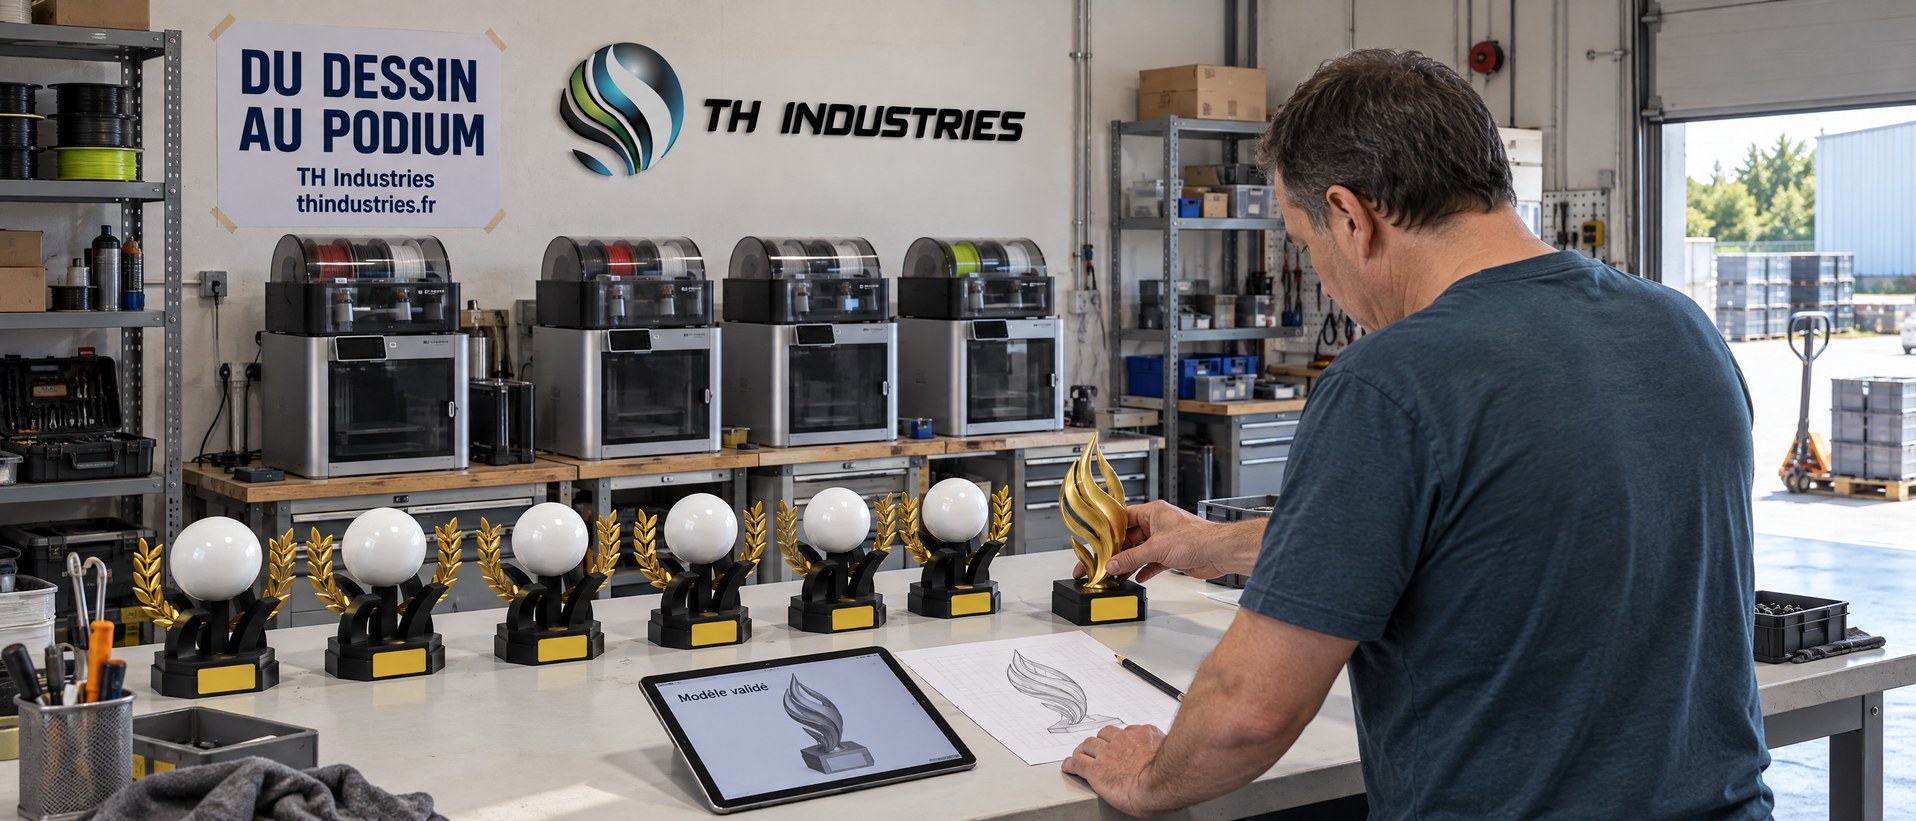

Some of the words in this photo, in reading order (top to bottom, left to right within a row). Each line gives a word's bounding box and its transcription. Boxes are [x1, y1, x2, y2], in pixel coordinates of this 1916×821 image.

[241, 49, 302, 96] DU
[323, 52, 477, 103] DESSIN
[239, 107, 302, 152] AU
[323, 109, 485, 156] PODIUM
[704, 98, 762, 132] TH
[780, 102, 1026, 141] INDUSTRIES
[297, 167, 326, 187] TH
[334, 168, 435, 188] Industries
[296, 194, 437, 213] thindustries.fr
[677, 687, 728, 703] Modèle
[730, 682, 769, 696] validé
